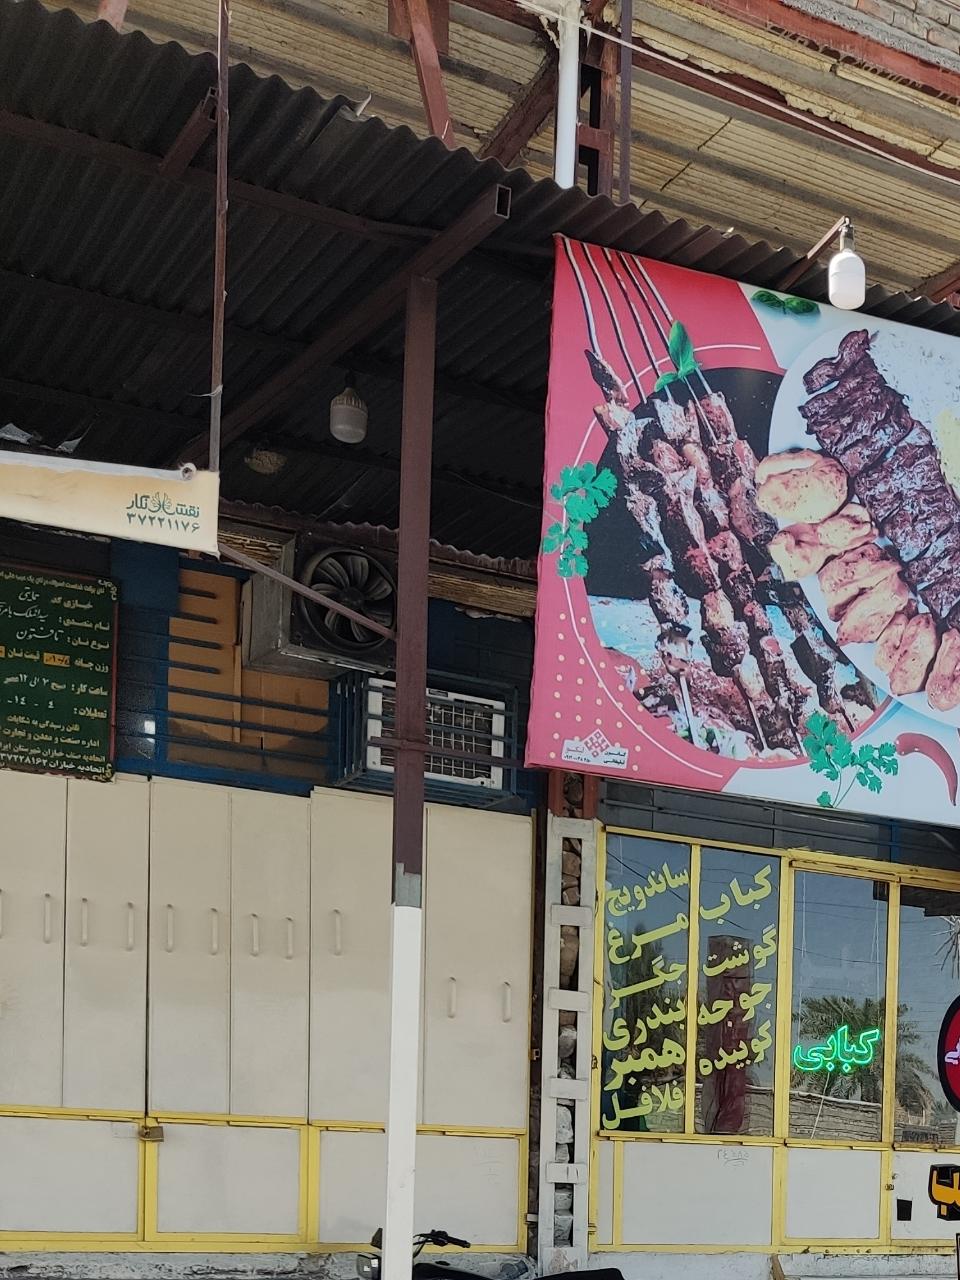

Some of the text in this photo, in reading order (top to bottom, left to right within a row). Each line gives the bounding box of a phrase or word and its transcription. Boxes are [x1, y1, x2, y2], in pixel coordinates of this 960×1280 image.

[126, 512, 200, 533] ۳۷۲۲۱۱۷۶
[699, 864, 773, 925] کباب
[607, 911, 690, 965] مرغ
[702, 923, 778, 978] گوشت
[609, 955, 687, 1010] جگر
[697, 980, 773, 1028] جوجه
[603, 997, 687, 1051] بندری
[699, 1020, 773, 1076] کوبیده
[793, 1025, 880, 1072] کبابی
[602, 1079, 684, 1130] فلافل
